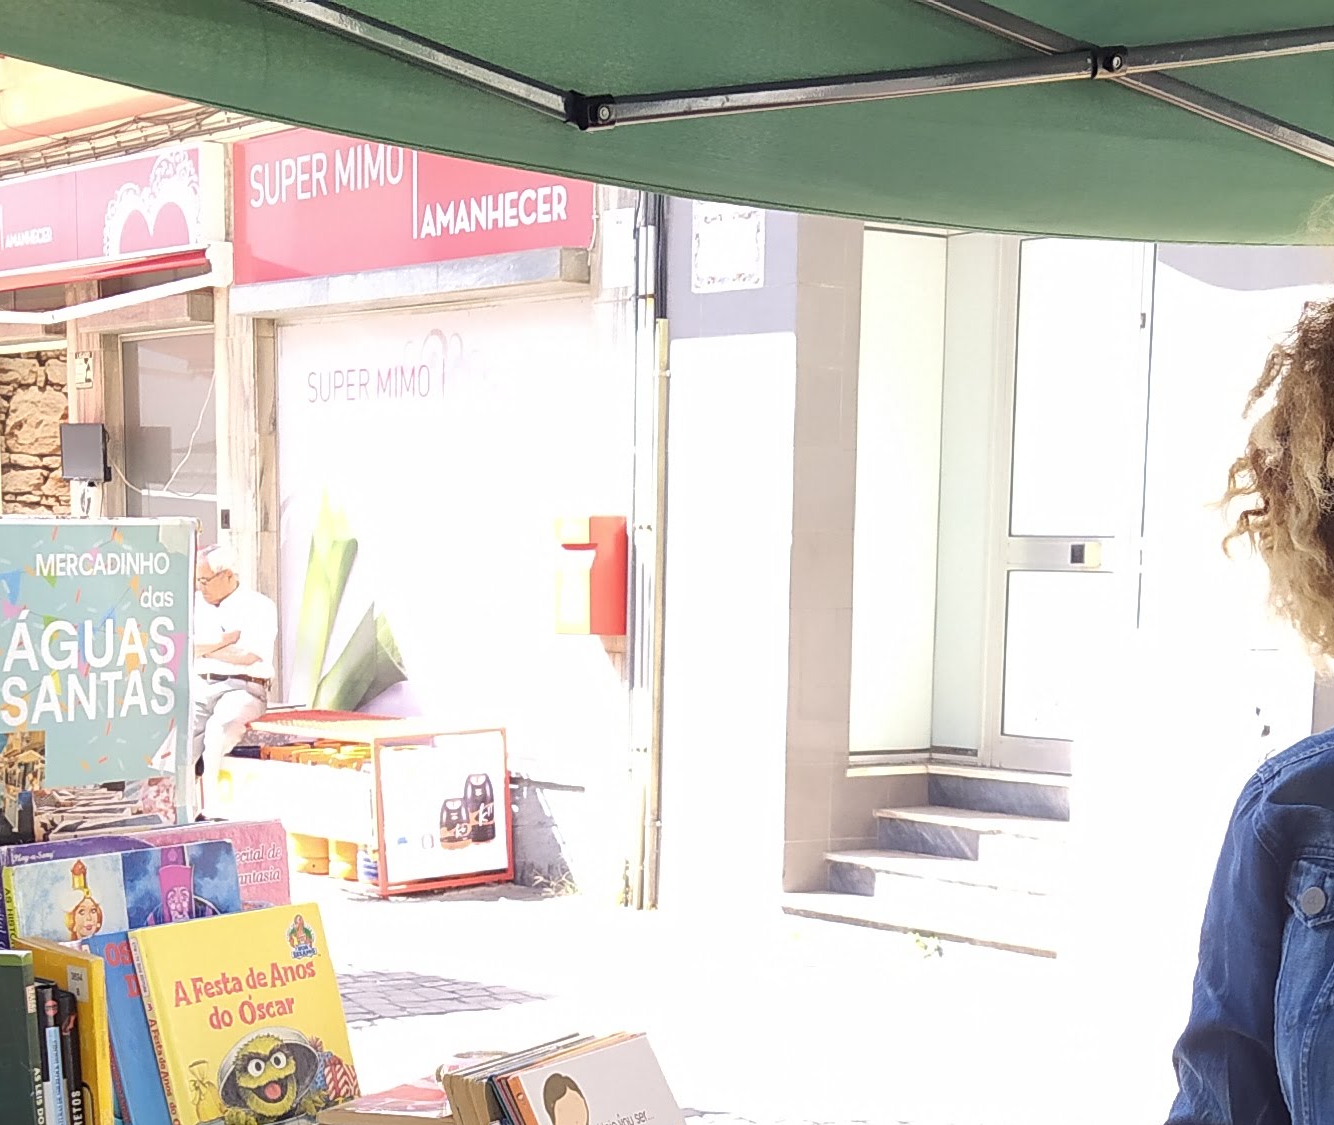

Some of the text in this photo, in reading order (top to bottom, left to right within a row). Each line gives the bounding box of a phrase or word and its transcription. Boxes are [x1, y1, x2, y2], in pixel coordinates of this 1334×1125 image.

[249, 143, 405, 207] SUPER MIMO
[420, 186, 568, 238] AMANHECER
[307, 363, 431, 403] SUPER MIMO
[36, 552, 170, 578] MERCADINHO
[140, 586, 174, 608] das
[2, 611, 176, 673] ÁGUAS
[0, 668, 176, 727] SANTAS
[236, 843, 283, 864] ecital de
[238, 866, 281, 885] antasia
[173, 960, 317, 1007] A Festa de Anos
[209, 994, 296, 1030] do Óscar
[150, 1028, 164, 1056] Festa
[160, 1069, 173, 1097] Anos
[168, 1101, 177, 1115] do
[34, 1083, 44, 1107] LEIS
[37, 1109, 46, 1125] DO
